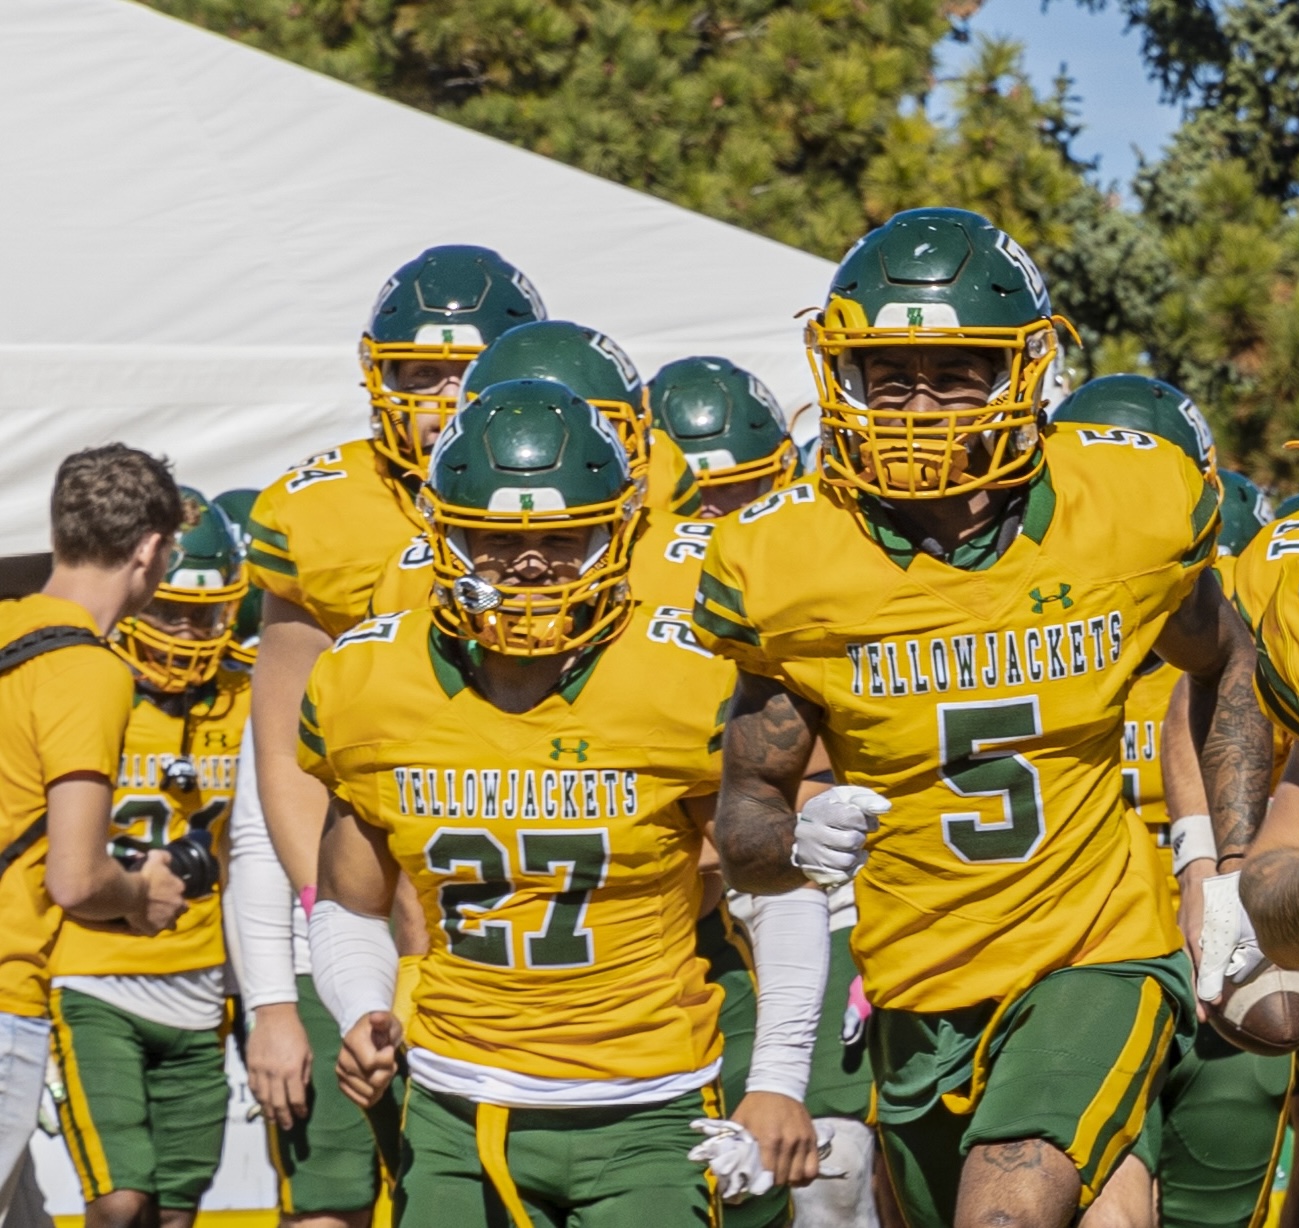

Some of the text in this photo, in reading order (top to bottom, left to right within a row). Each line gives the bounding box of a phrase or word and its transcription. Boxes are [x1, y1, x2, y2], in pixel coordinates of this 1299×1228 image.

[1077, 428, 1158, 451] 5
[739, 484, 815, 525] 5
[332, 609, 412, 654] 7
[846, 610, 1123, 697] YELLOWJACKETS
[394, 767, 638, 819] YELLOWJACKETS
[936, 694, 1047, 864] 5
[423, 827, 610, 970] 27
